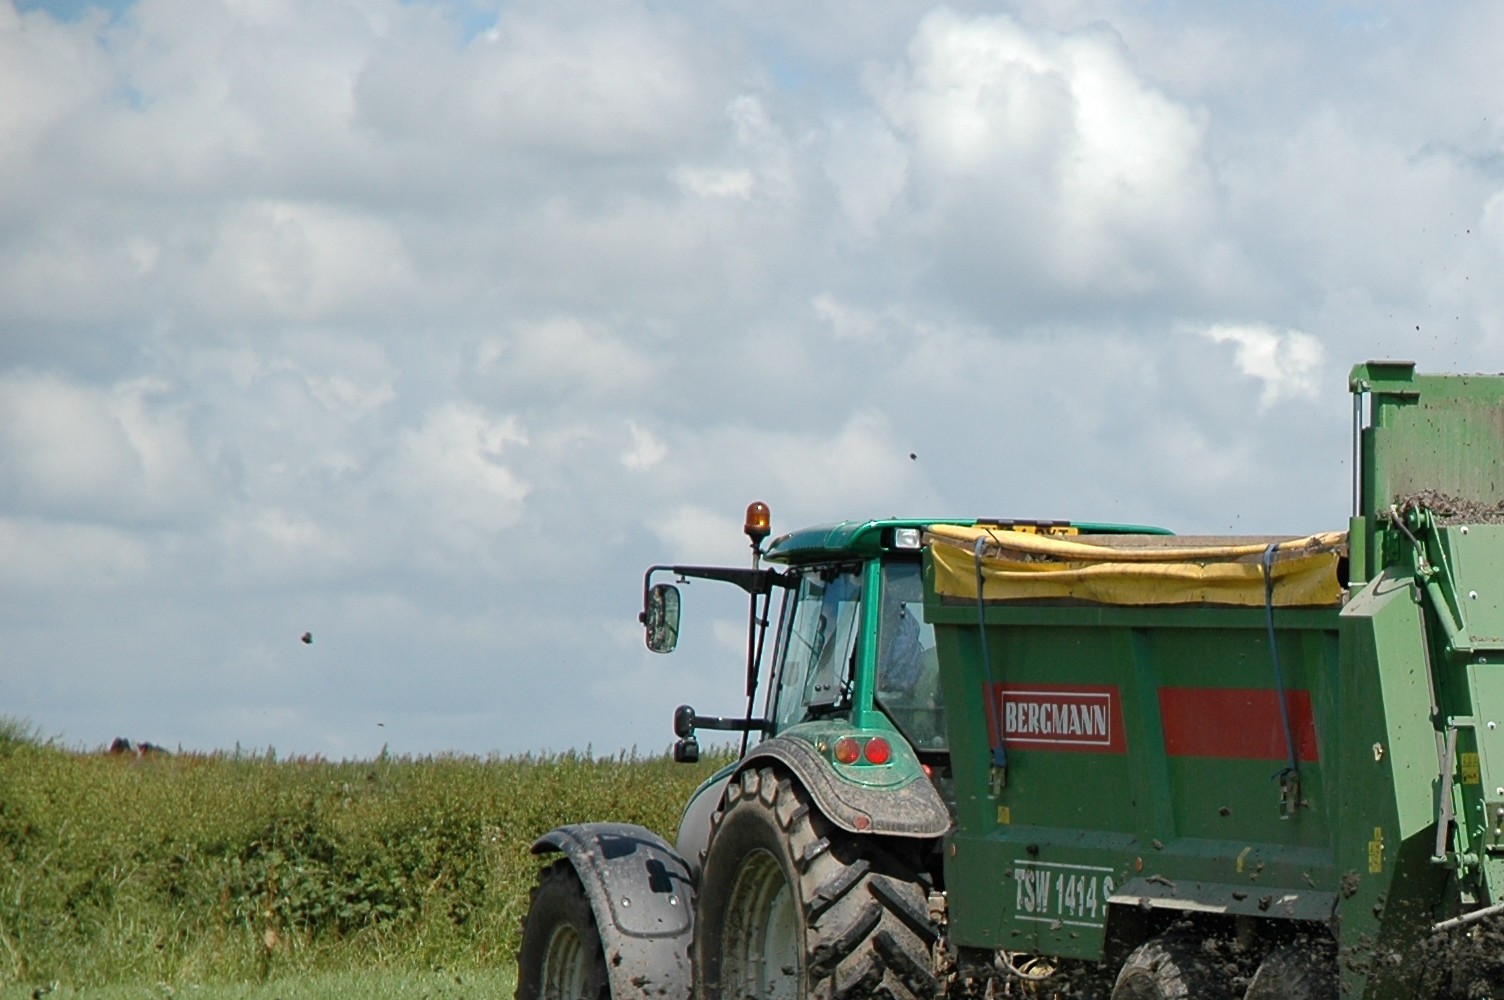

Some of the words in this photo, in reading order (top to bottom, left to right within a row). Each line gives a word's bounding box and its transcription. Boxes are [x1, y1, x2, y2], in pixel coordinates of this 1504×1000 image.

[1005, 701, 1106, 736] BERGMANN
[1014, 868, 1051, 913] TSW
[1056, 873, 1097, 918] 1414
